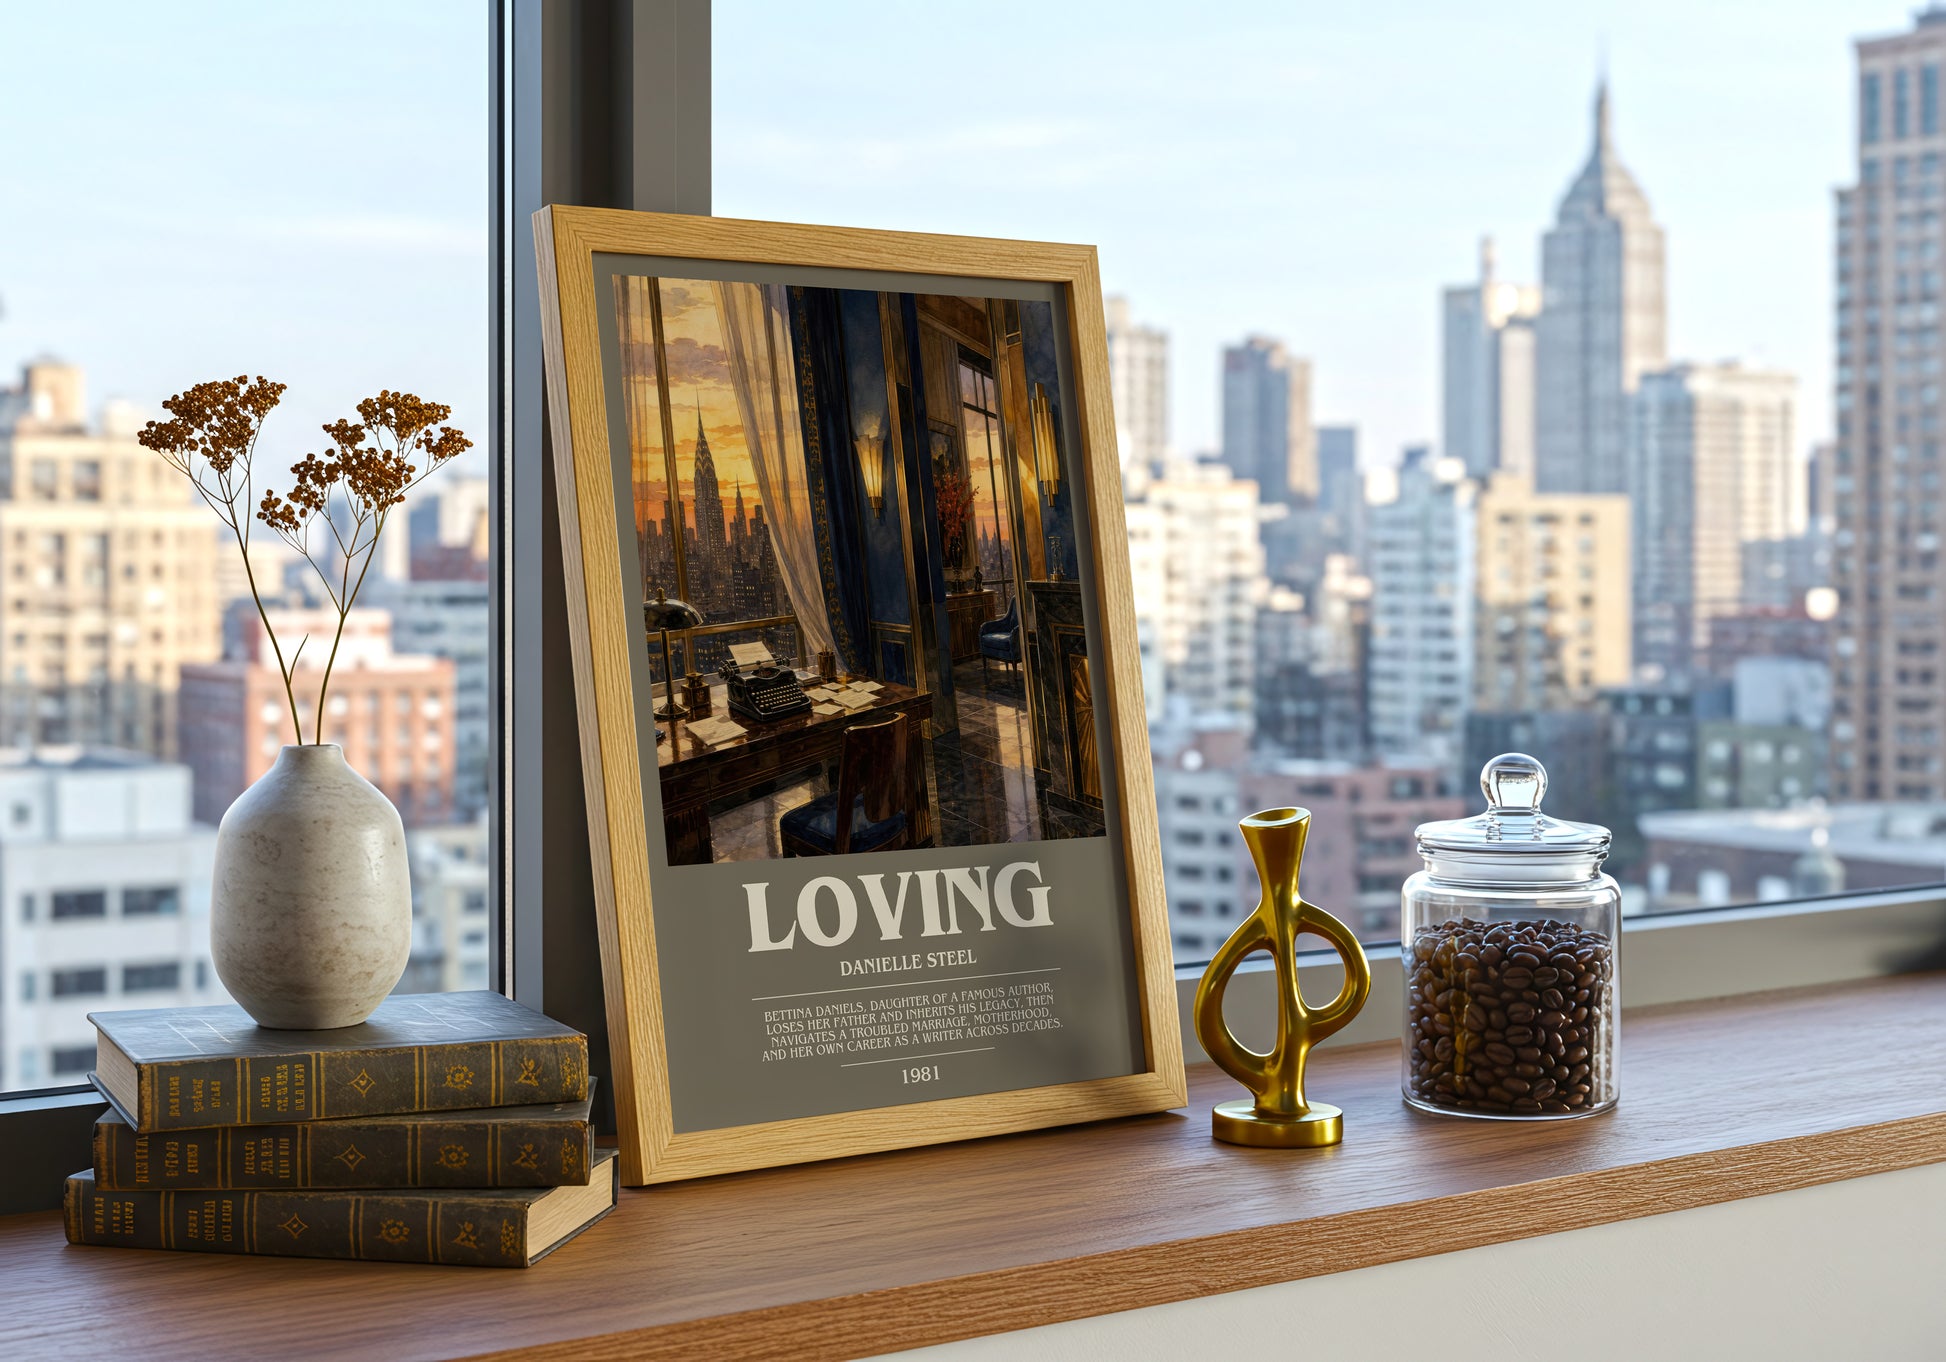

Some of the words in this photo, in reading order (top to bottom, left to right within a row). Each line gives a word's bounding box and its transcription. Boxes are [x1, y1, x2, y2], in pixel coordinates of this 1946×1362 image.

[742, 860, 1055, 953] LOVING
[839, 953, 922, 977] DANIELLE
[926, 949, 977, 968] STEEL
[764, 1007, 813, 1022] BETTINA
[815, 1001, 867, 1017] DANIELS,
[870, 994, 930, 1011] DAUGHTER
[932, 993, 948, 1004] OF
[950, 992, 959, 1003] A
[961, 987, 1005, 1001] FAMOUS
[1008, 982, 1054, 997] AUTHOR,
[766, 1021, 804, 1035] LOSES
[807, 1018, 831, 1031] HER
[833, 1013, 877, 1028] FATHER
[879, 1010, 903, 1023] AND
[906, 1004, 956, 1020] INHERITS
[958, 1003, 977, 1014] HIS
[979, 997, 1024, 1012] LEGACY,
[1025, 994, 1054, 1007] THEN
[762, 1048, 787, 1062] AND
[790, 1045, 814, 1059] HER
[816, 1042, 844, 1056] OWN
[846, 1037, 891, 1052] CAREER
[894, 1034, 909, 1047] AS
[911, 1034, 920, 1045] A
[922, 1028, 963, 1043] WRITER
[966, 1024, 1009, 1039] ACROSS
[1012, 1017, 1064, 1033] DECADES.
[771, 1030, 836, 1048] NAVIGATES
[839, 1029, 847, 1040] A
[849, 1022, 909, 1039] TROUBLED
[912, 1016, 971, 1032] MARRIAGE,
[973, 1007, 1052, 1025] MOTHERHOOD,
[901, 1065, 941, 1085] 1981
